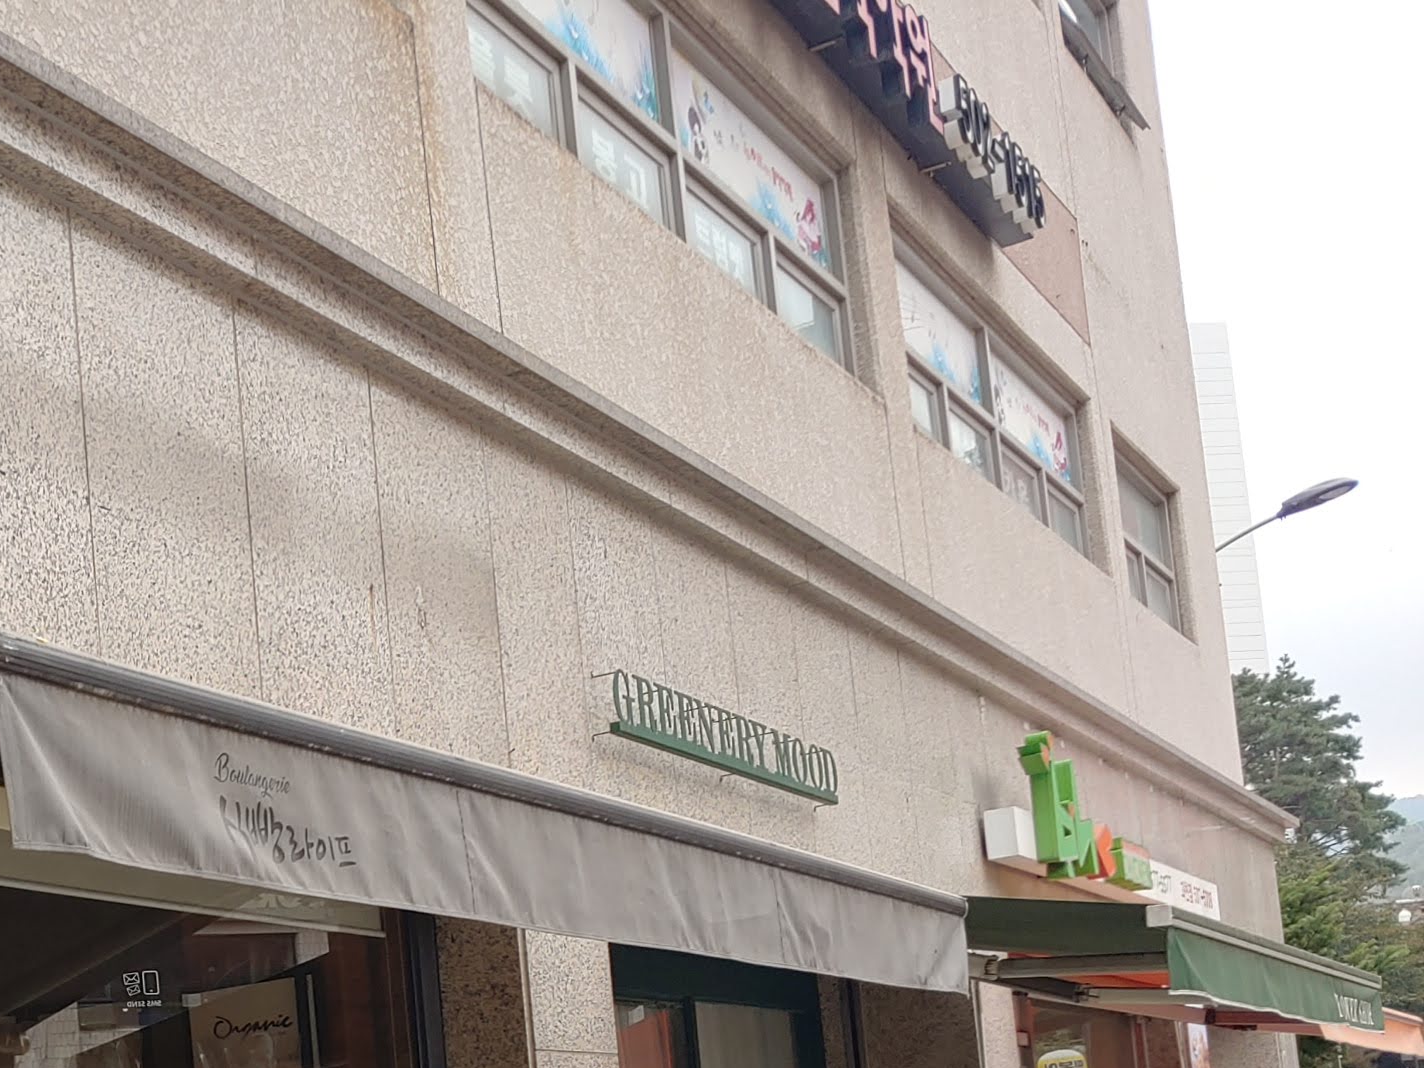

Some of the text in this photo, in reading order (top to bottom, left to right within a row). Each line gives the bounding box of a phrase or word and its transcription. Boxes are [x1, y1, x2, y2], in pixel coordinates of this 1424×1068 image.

[612, 668, 838, 795] GREENERY MOOD
[214, 752, 290, 798] Boulangerie
[214, 1014, 293, 1039] Organic
